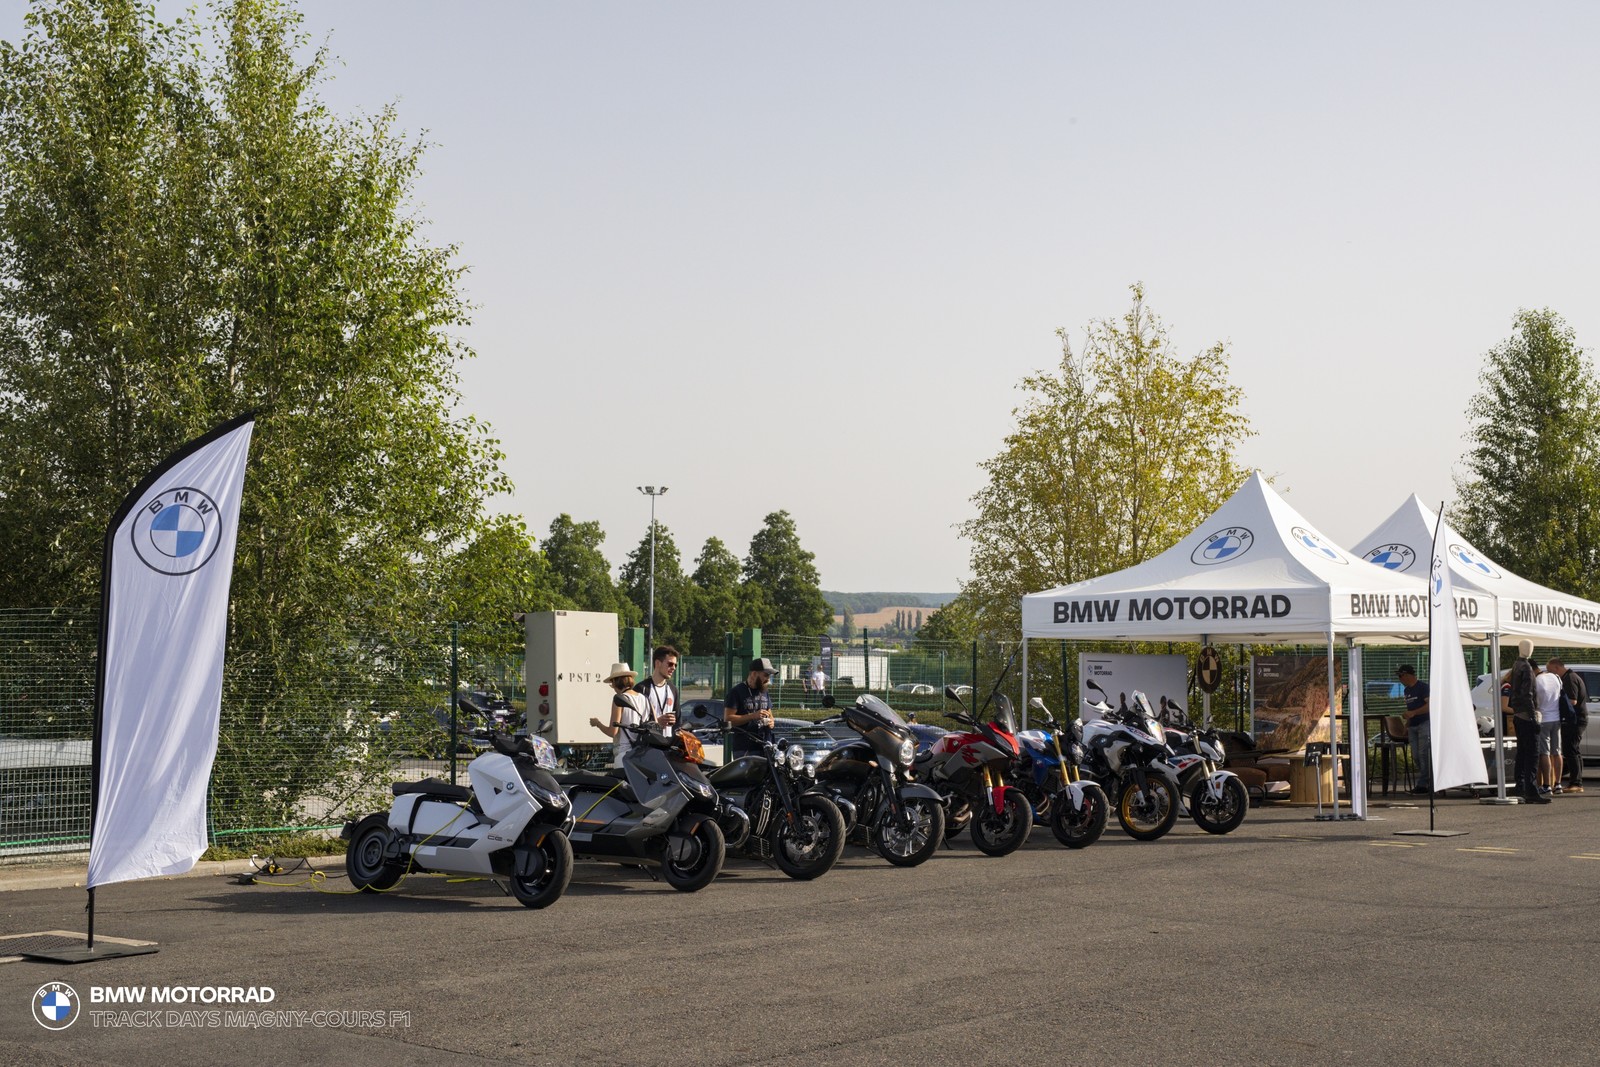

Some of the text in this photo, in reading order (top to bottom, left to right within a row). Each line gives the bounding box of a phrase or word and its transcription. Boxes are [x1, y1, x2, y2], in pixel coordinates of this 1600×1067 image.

[148, 491, 213, 515] BMW
[1208, 529, 1250, 543] BMW
[1371, 545, 1412, 557] BMW
[1053, 594, 1292, 623] BMW MOTORRAD
[1351, 594, 1478, 619] BMW MOTAD
[1512, 601, 1543, 624] BMW
[569, 672, 602, 683] PST 2
